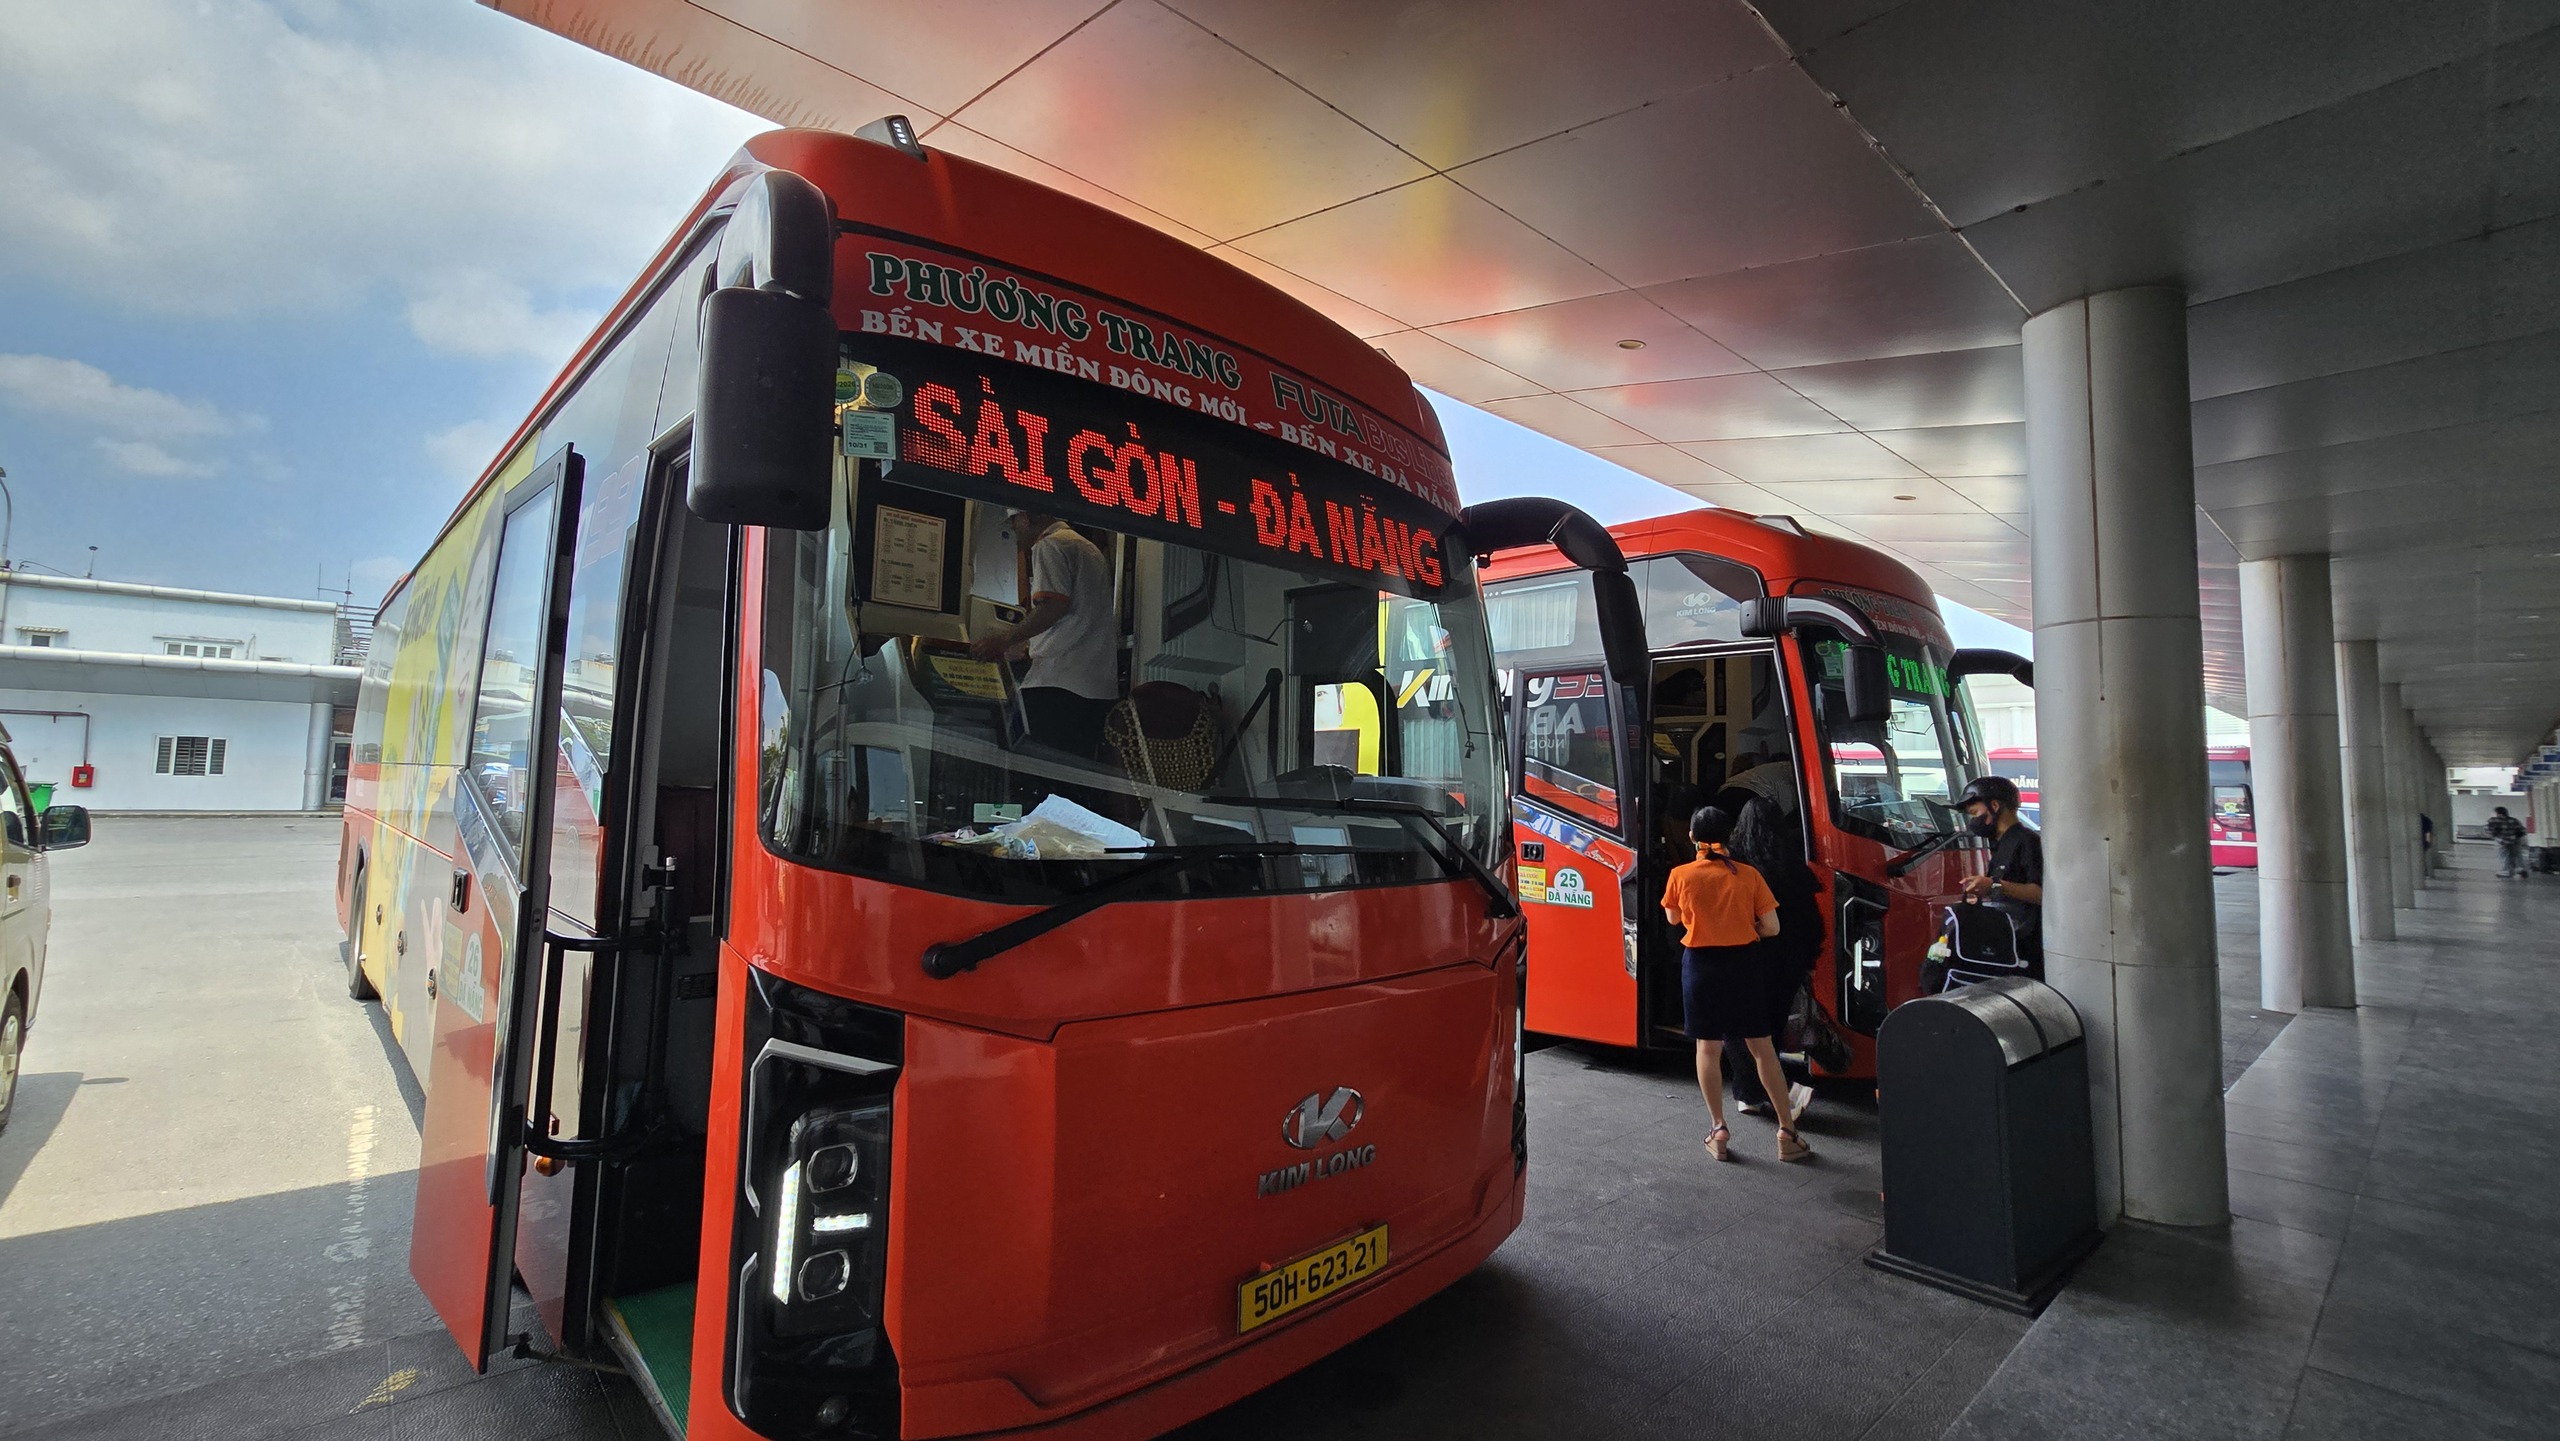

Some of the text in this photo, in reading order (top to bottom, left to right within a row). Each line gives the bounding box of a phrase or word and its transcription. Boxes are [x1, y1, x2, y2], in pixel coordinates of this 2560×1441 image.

[865, 252, 1242, 391] PHƯƠNG TRANG
[860, 305, 943, 344] BẾN
[954, 326, 1006, 359] XE
[1013, 341, 1101, 383] MIỀN
[1108, 365, 1193, 408] ĐÔNG
[1199, 392, 1248, 427] MỚI
[1279, 420, 1337, 459] BẾN
[1343, 446, 1377, 476] XE
[1381, 463, 1413, 493] ĐÀ
[1269, 371, 1367, 445] FUTA
[908, 375, 1054, 493] SÀI
[1067, 421, 1202, 529] GÒN
[1250, 471, 1324, 558] ĐÀ
[1693, 606, 1716, 615] LONG
[1548, 889, 1561, 902] ĐÀ
[1560, 872, 1578, 888] 25
[468, 941, 480, 977] 26
[1257, 1144, 1377, 1200] KIM LONG
[1254, 1236, 1378, 1318] 50H-623.21
